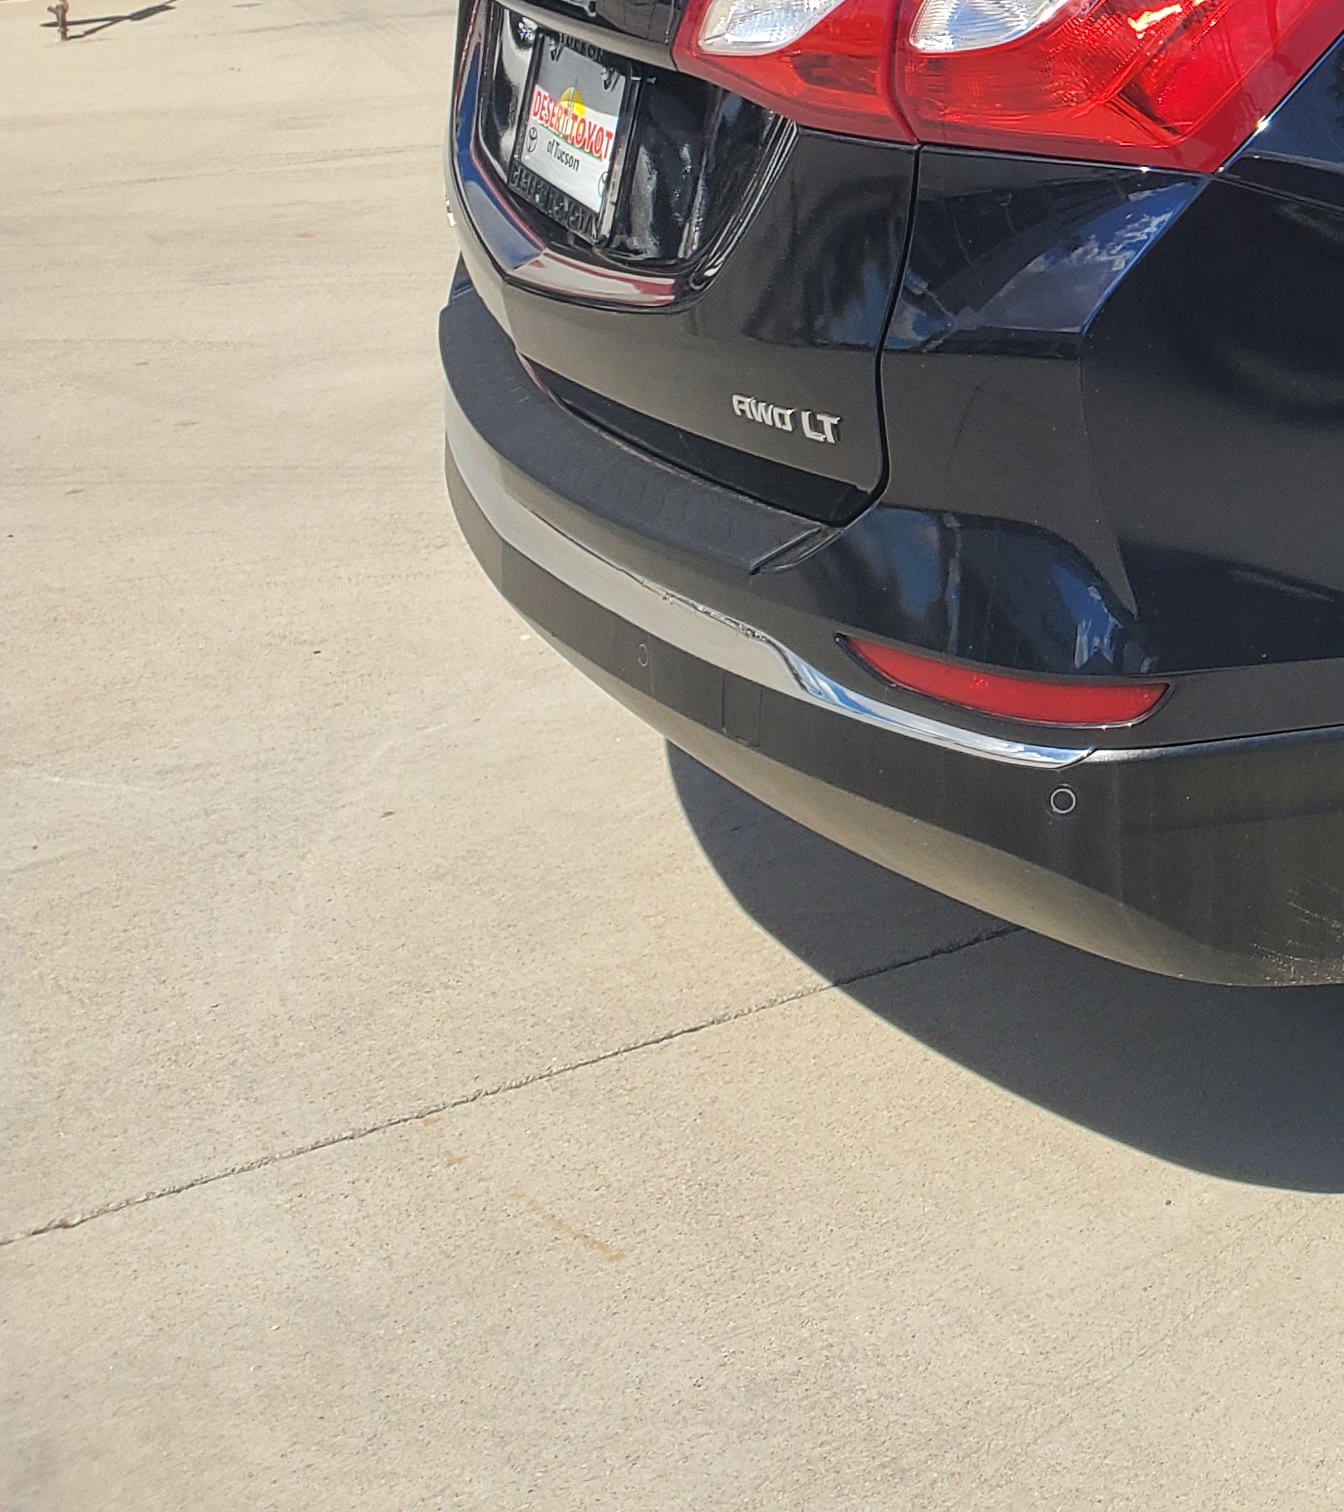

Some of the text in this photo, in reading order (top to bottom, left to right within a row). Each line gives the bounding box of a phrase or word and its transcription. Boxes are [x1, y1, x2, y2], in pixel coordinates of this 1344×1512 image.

[533, 90, 613, 161] DESERT TOYOT
[546, 139, 580, 172] of Tucson
[732, 394, 841, 444] AWD LT
